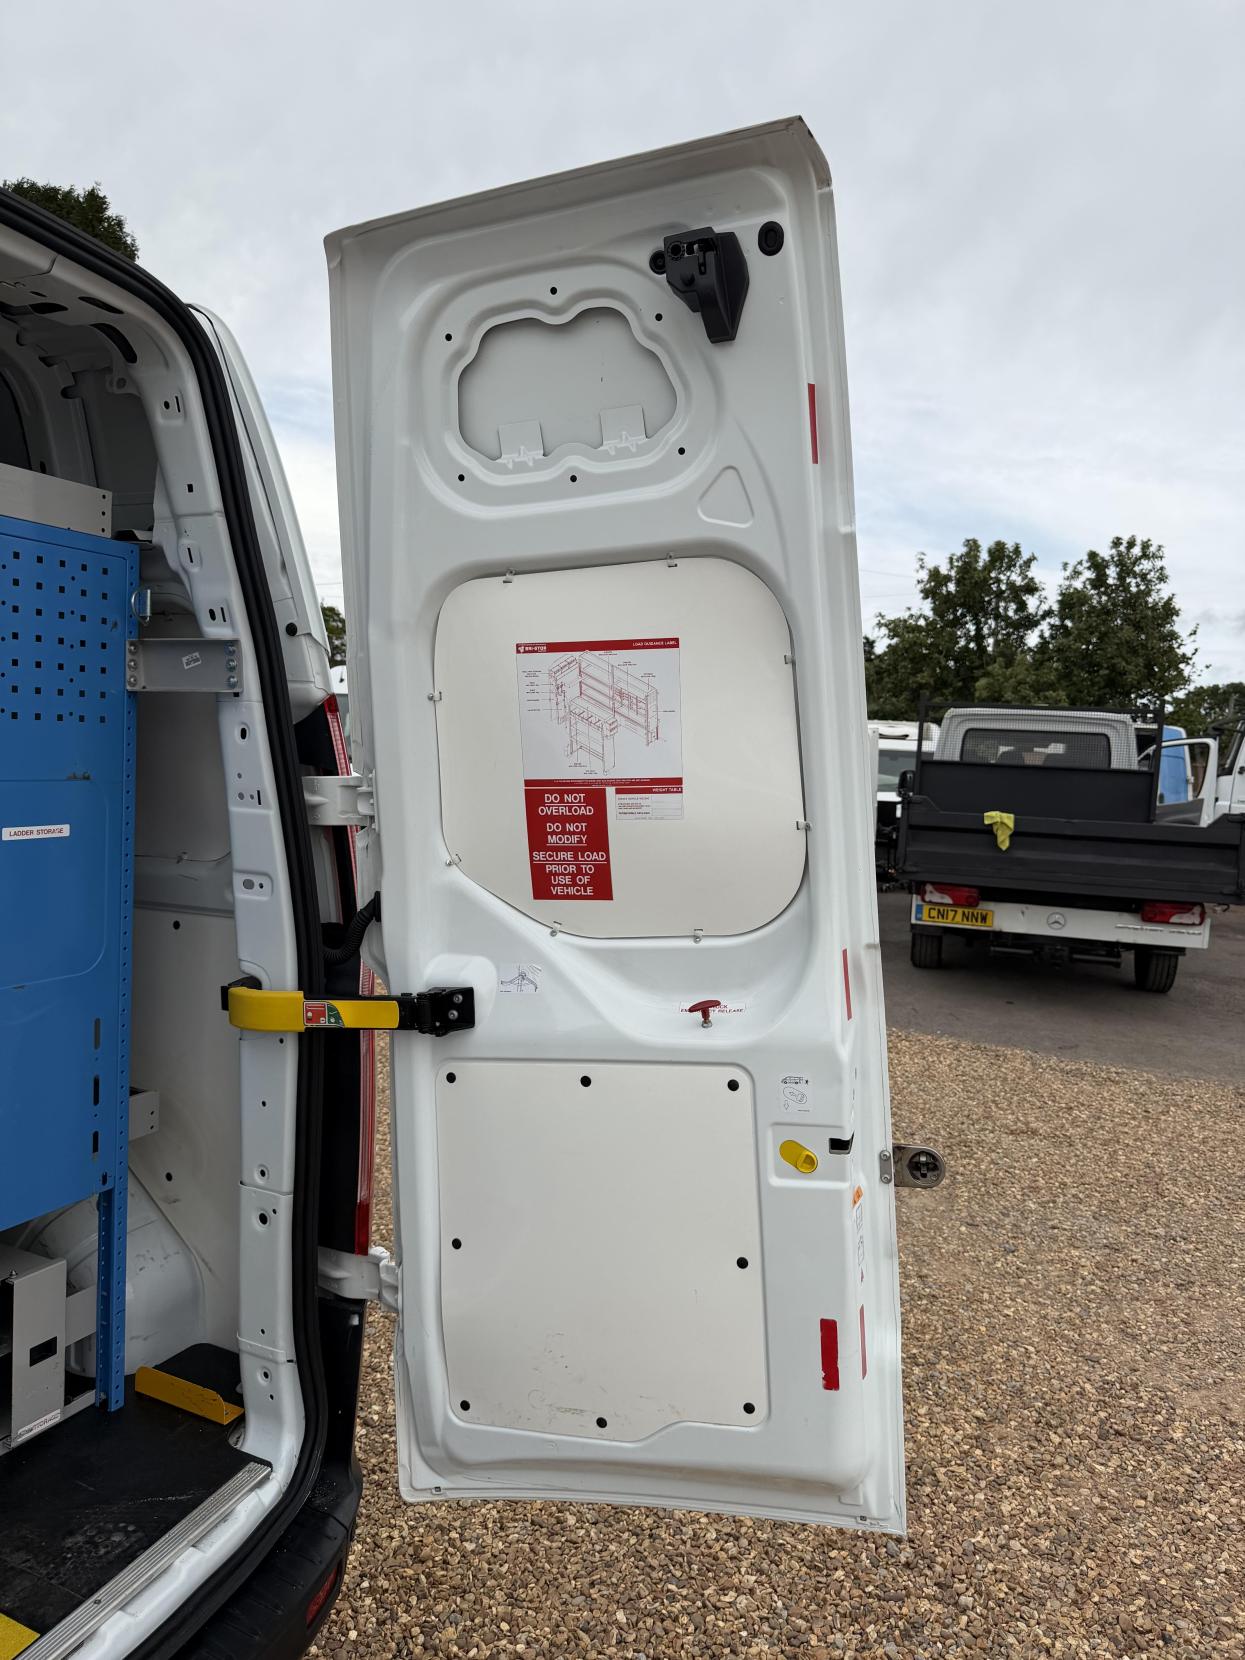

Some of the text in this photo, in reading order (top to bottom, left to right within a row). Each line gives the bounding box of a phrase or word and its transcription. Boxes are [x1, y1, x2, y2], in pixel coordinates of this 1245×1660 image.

[544, 794, 586, 803] DO NOT
[538, 806, 594, 816] OVERLOAD
[9, 827, 64, 837] LADDER STORAGE
[546, 823, 588, 832] DO NOT
[547, 834, 588, 844] MODIFY
[532, 851, 607, 861] SECURE LOAD
[545, 864, 595, 874] PRIOR TO
[551, 875, 591, 885] USE OF
[550, 886, 594, 896] VEHICLE
[928, 907, 988, 924] CN17 NNW
